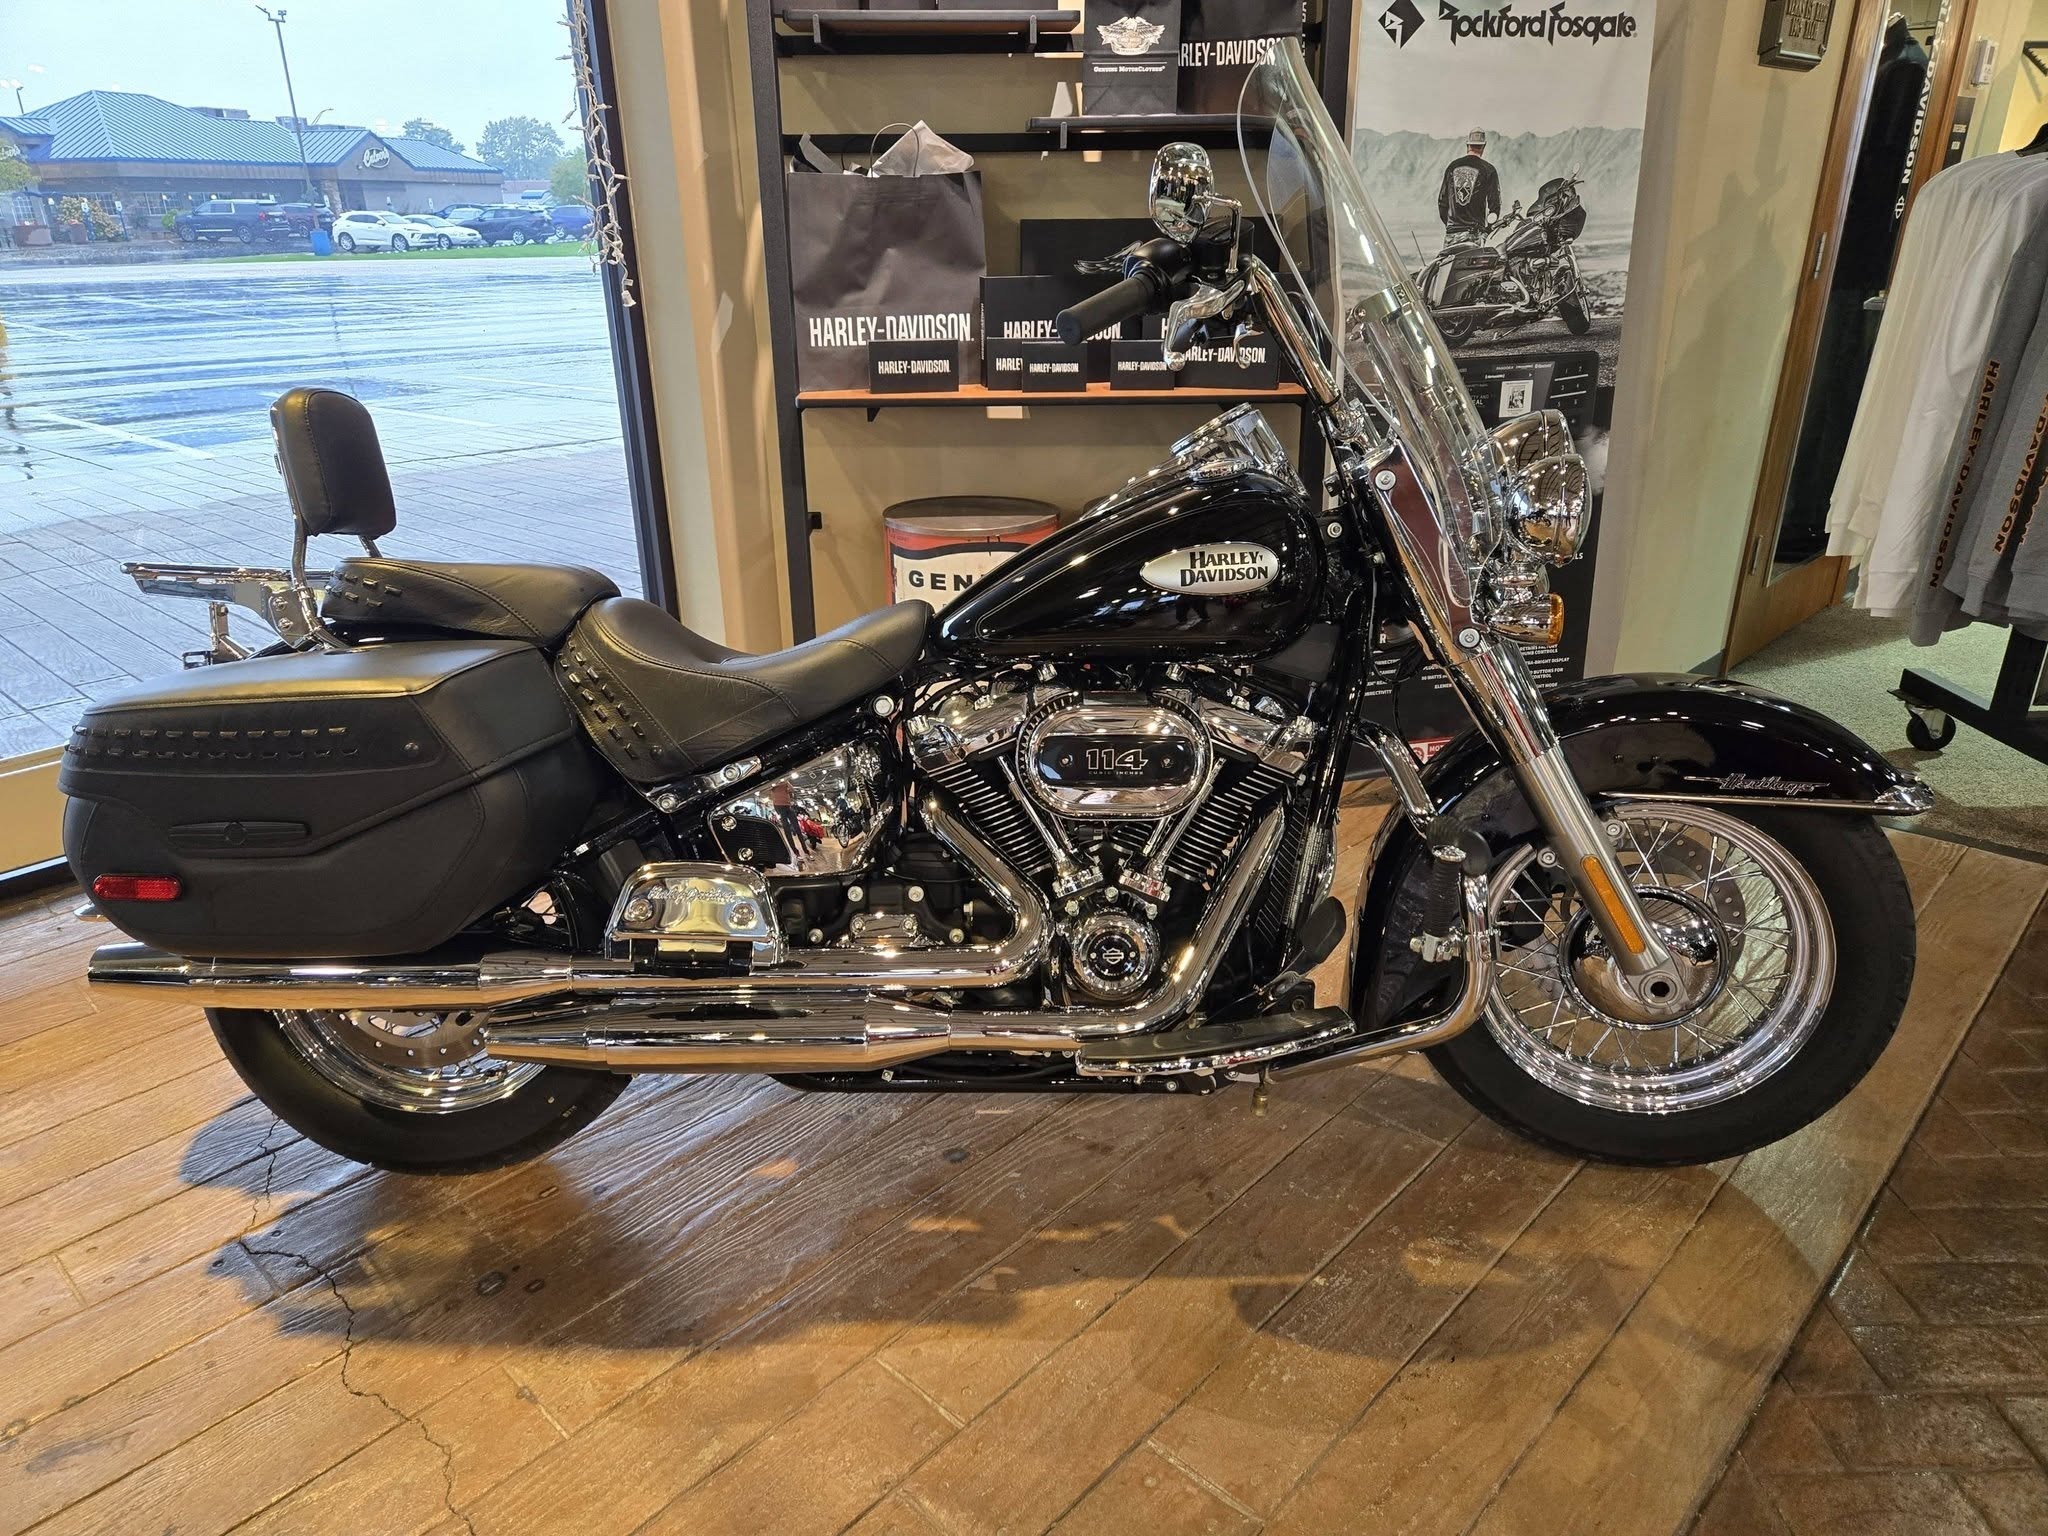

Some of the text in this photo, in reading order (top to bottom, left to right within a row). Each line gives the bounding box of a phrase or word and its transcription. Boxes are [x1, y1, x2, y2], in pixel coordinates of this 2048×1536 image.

[1438, 0, 1637, 46] Rockford Fosgate
[1929, 360, 2001, 588] HARLEY-DAVIDSON
[909, 569, 978, 591] GEN
[1180, 566, 1268, 587] DAVIDSON
[1086, 748, 1149, 770] 114
